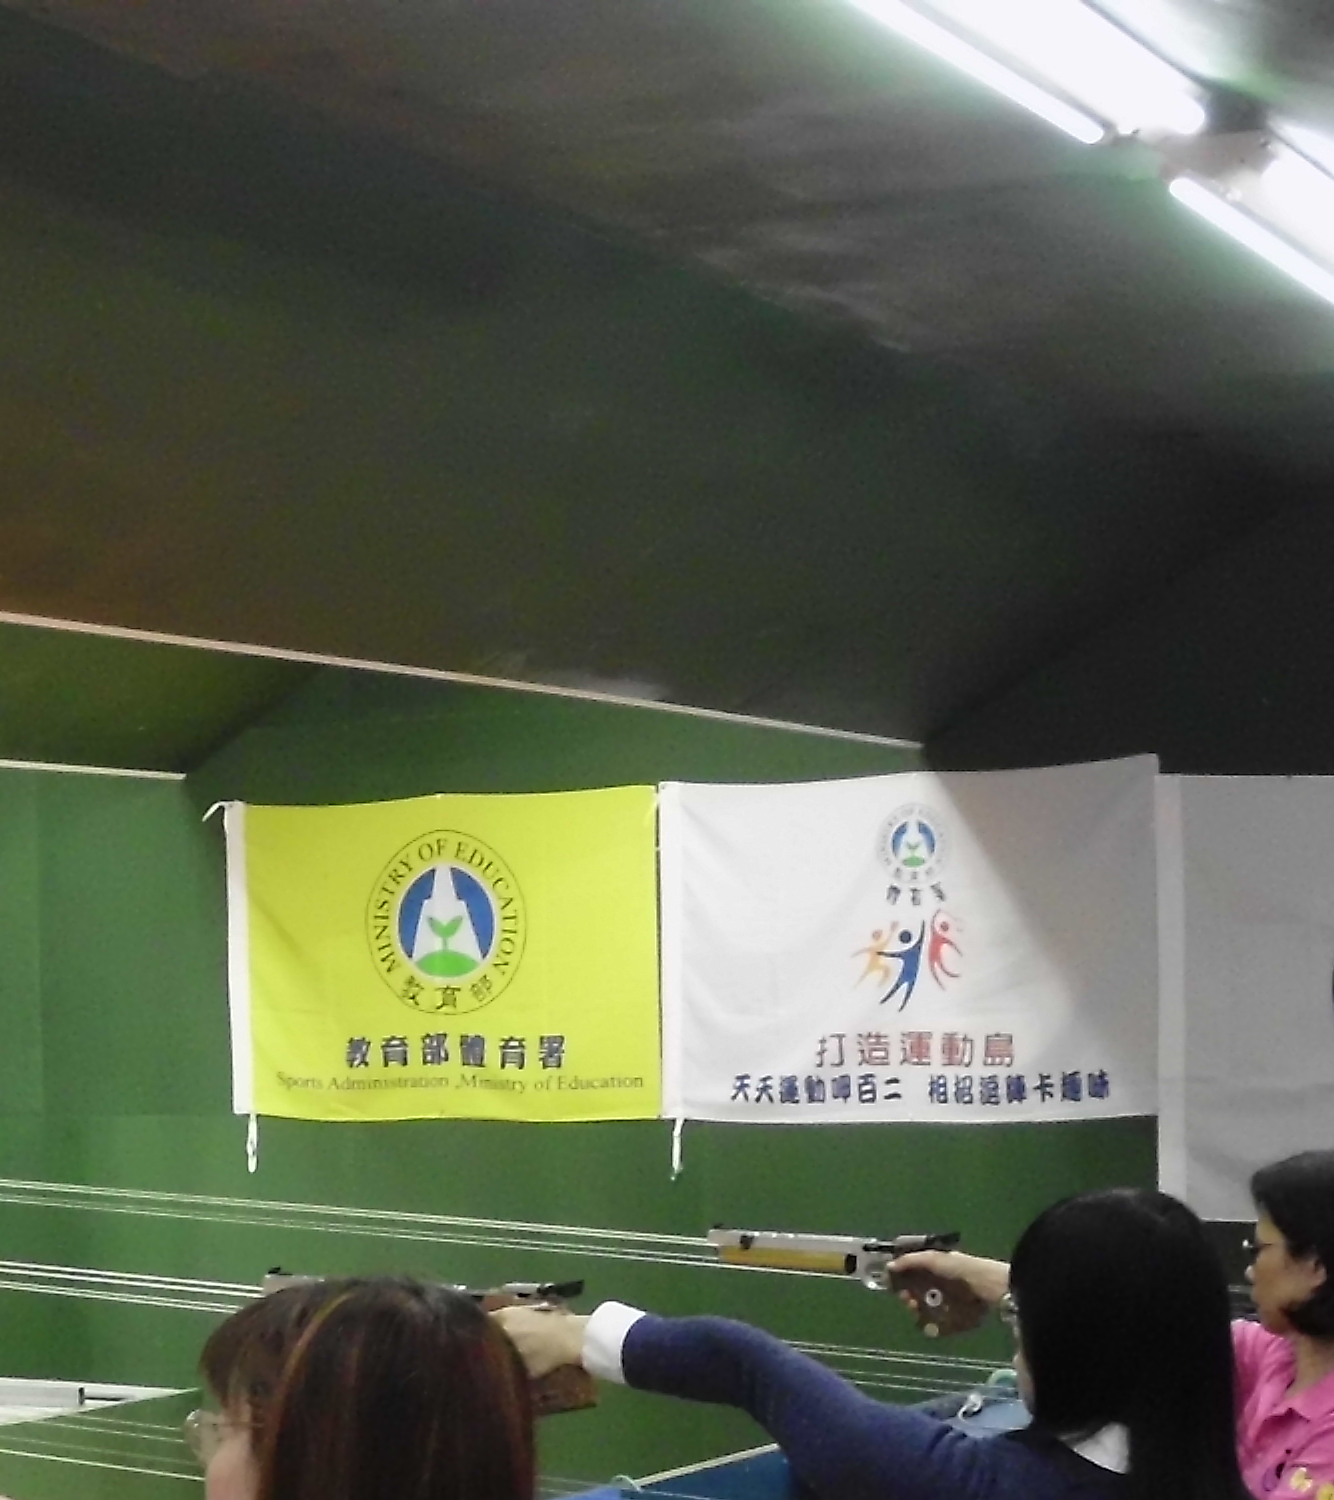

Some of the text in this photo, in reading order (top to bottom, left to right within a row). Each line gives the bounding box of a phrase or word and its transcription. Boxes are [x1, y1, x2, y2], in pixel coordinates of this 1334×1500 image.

[373, 837, 518, 977] MINISTRY OF EDUCATION
[346, 1032, 565, 1070] 教育部體育署
[815, 1031, 1014, 1067] 打造運動島
[276, 1071, 323, 1091] Sports
[327, 1075, 450, 1091] Administration
[534, 1075, 553, 1091] of
[557, 1074, 644, 1090] Education
